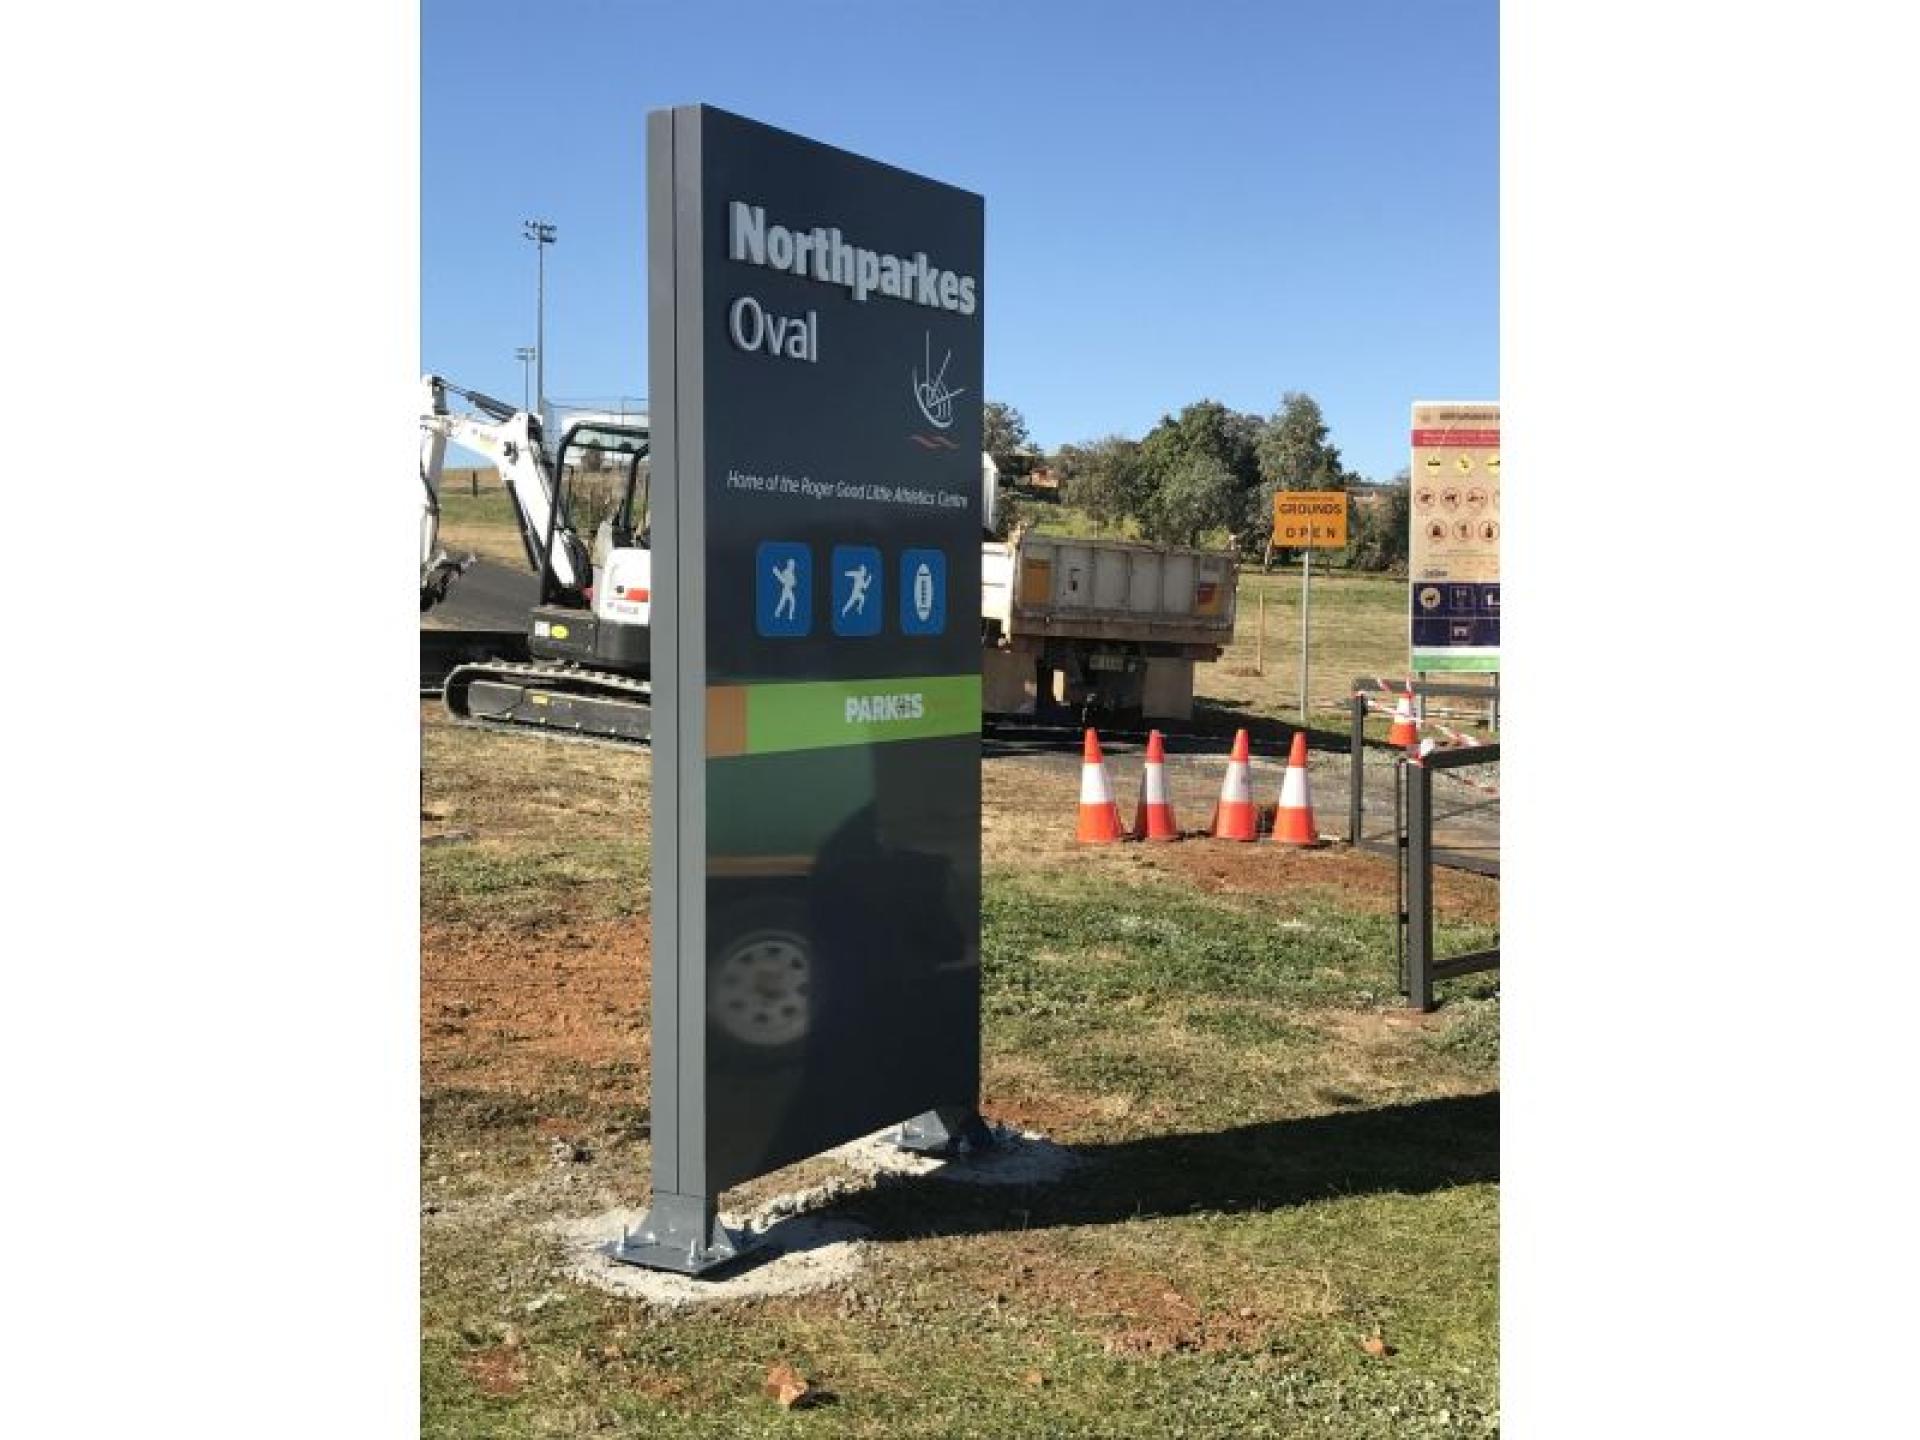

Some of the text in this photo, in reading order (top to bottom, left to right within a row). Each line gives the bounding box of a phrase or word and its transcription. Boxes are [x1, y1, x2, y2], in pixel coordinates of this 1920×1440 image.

[729, 201, 976, 315] Northparkes
[730, 297, 817, 363] Oval
[727, 470, 764, 490] Home
[765, 474, 778, 491] of
[780, 475, 800, 493] the
[801, 477, 834, 500] Roger
[1279, 503, 1342, 514] GROUNDS
[845, 693, 923, 723] PARKES
